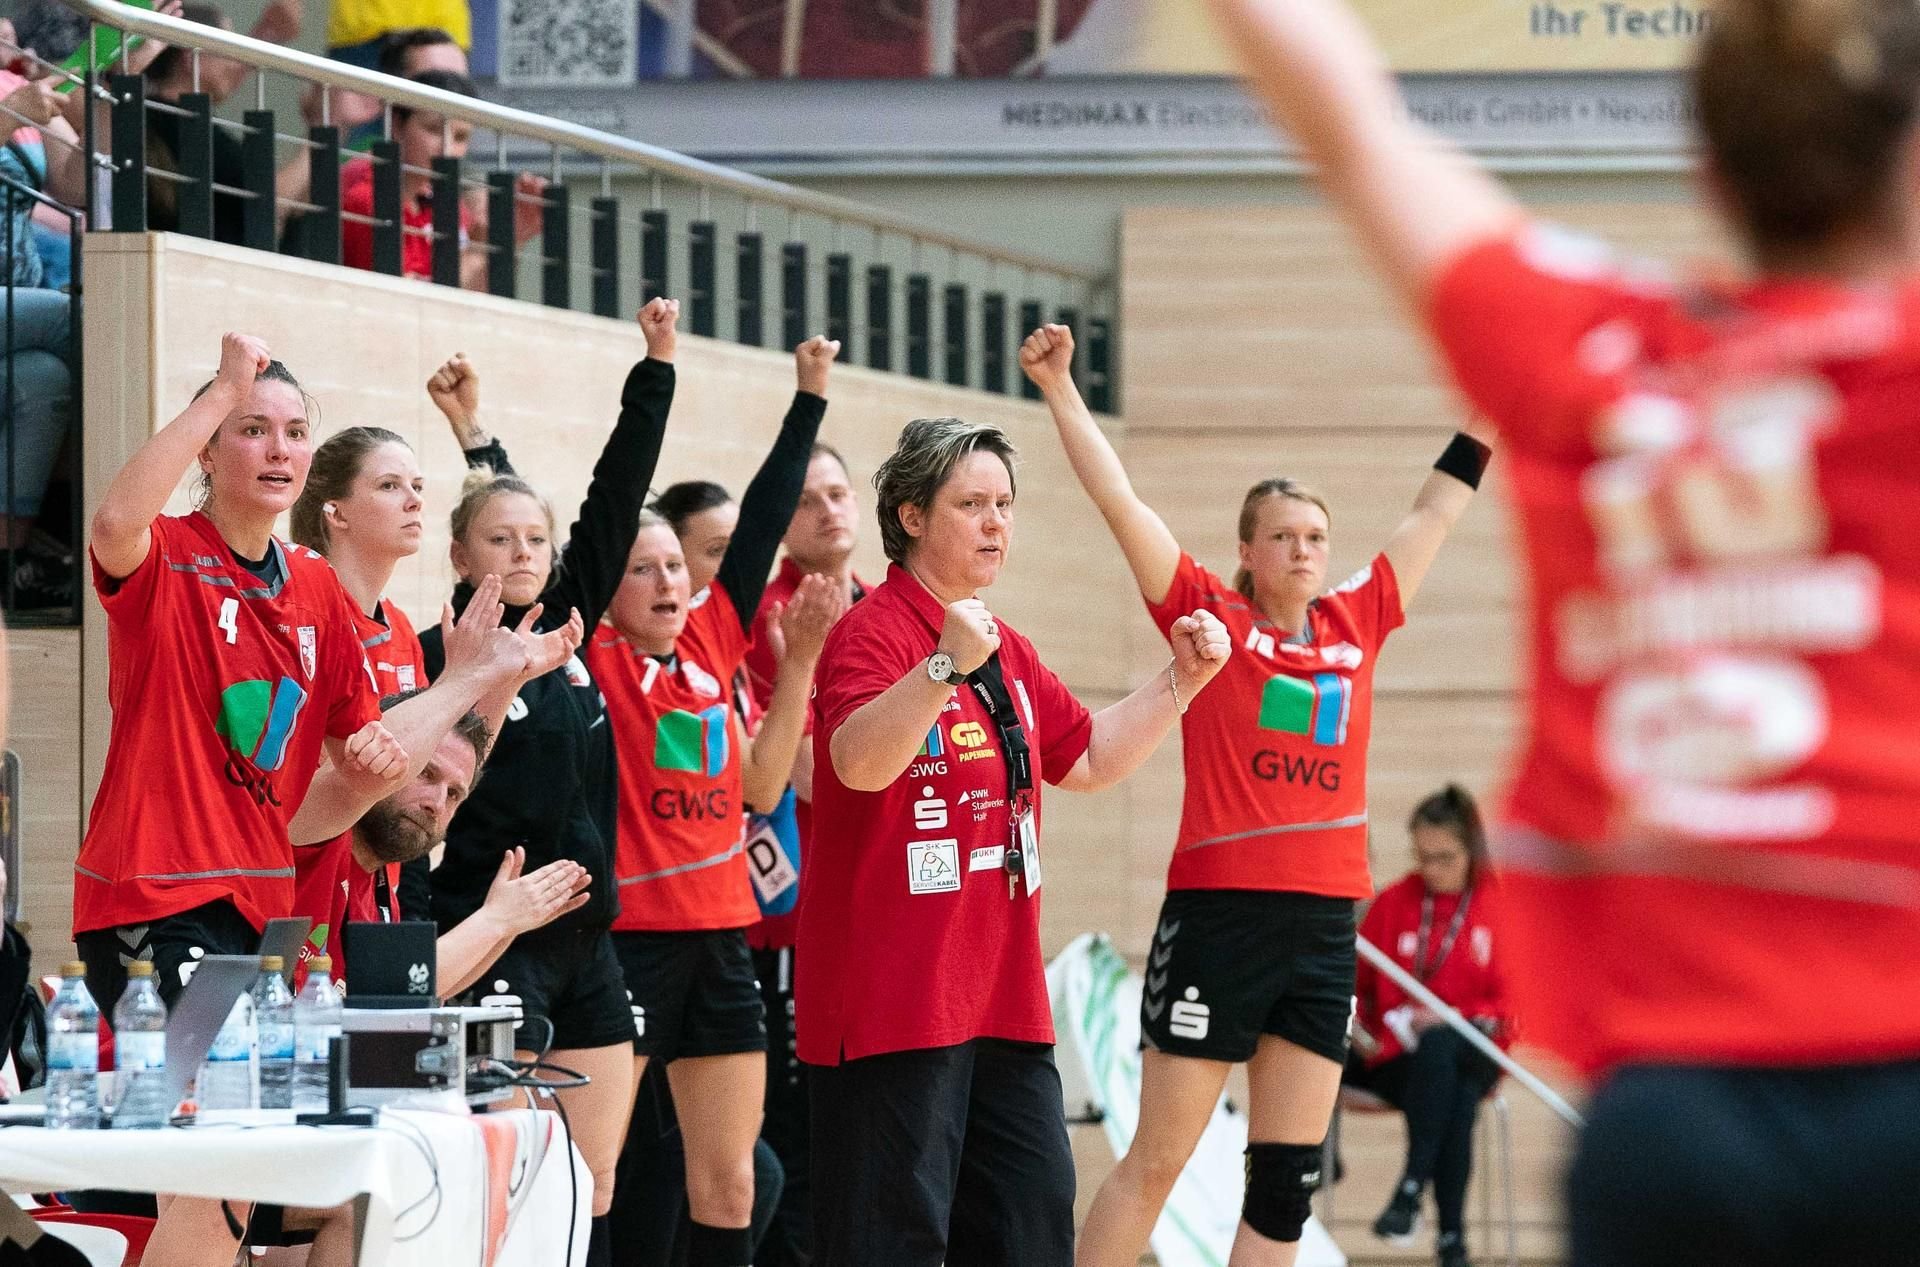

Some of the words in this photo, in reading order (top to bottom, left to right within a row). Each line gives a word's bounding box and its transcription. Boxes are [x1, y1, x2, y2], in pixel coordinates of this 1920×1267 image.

[1529, 4, 1586, 36] Ihr
[1001, 102, 1147, 127] MEDIMAX
[1484, 99, 1572, 125] GmbH
[217, 597, 240, 645] 4
[973, 682, 996, 715] hummel
[959, 749, 996, 762] PAPENBURG
[1251, 748, 1341, 792] GWG
[651, 788, 729, 820] GWG
[970, 789, 989, 799] SWH
[971, 799, 1004, 811] Stadtwerke
[747, 838, 777, 877] D
[925, 843, 940, 851] S+K
[978, 848, 995, 858] UKH
